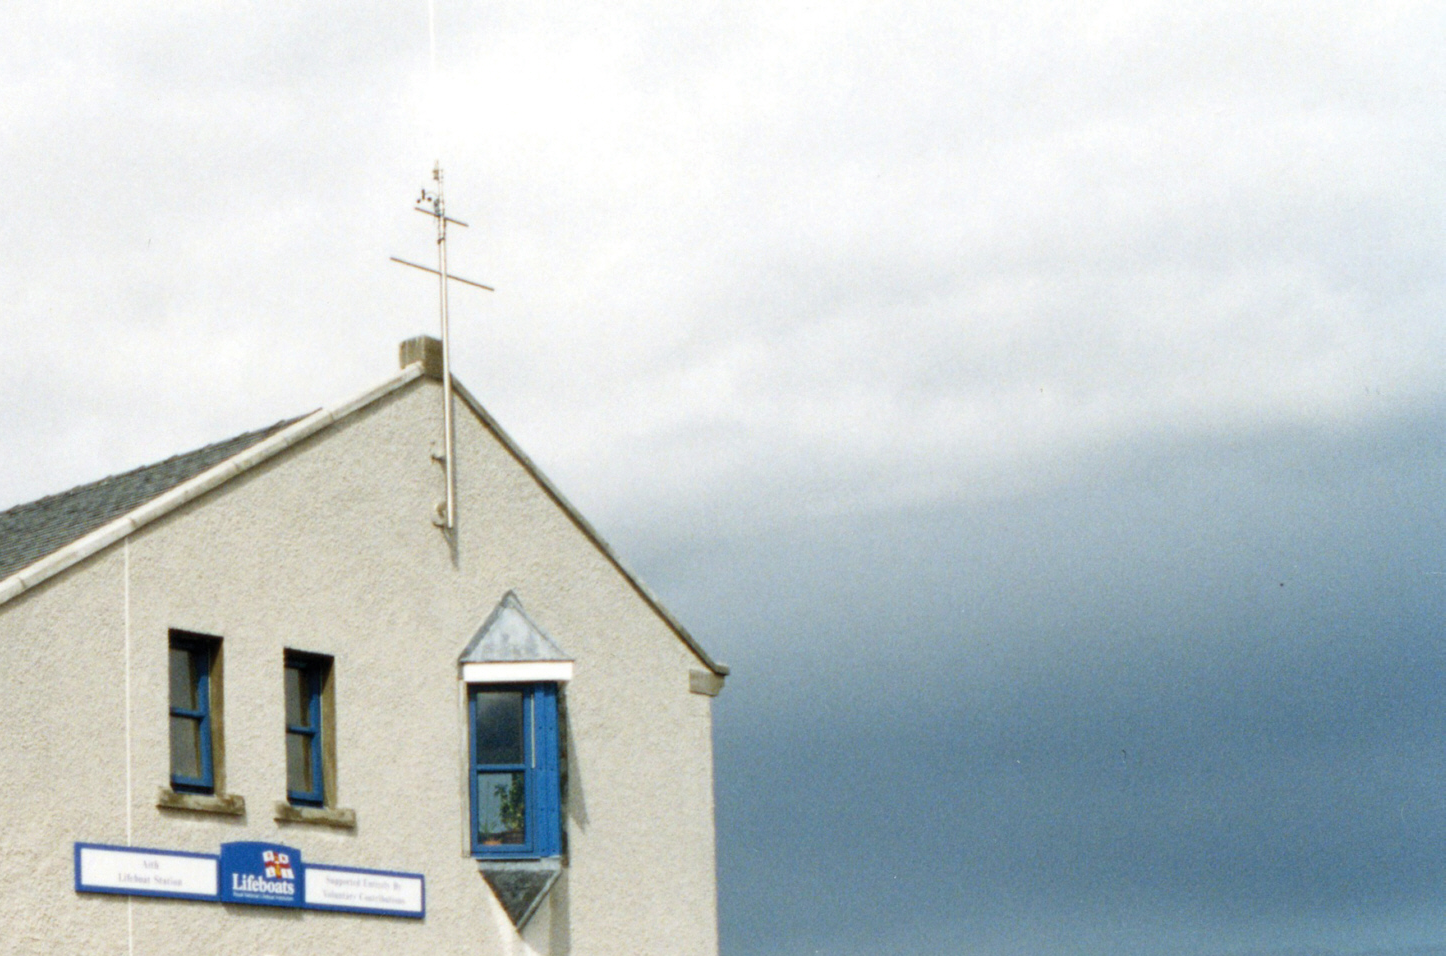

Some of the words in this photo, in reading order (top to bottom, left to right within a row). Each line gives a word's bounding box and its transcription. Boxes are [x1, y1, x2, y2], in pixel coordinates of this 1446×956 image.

[118, 873, 150, 884] Lifeboat
[154, 875, 183, 886] Station
[232, 873, 295, 895] Lifeboats
